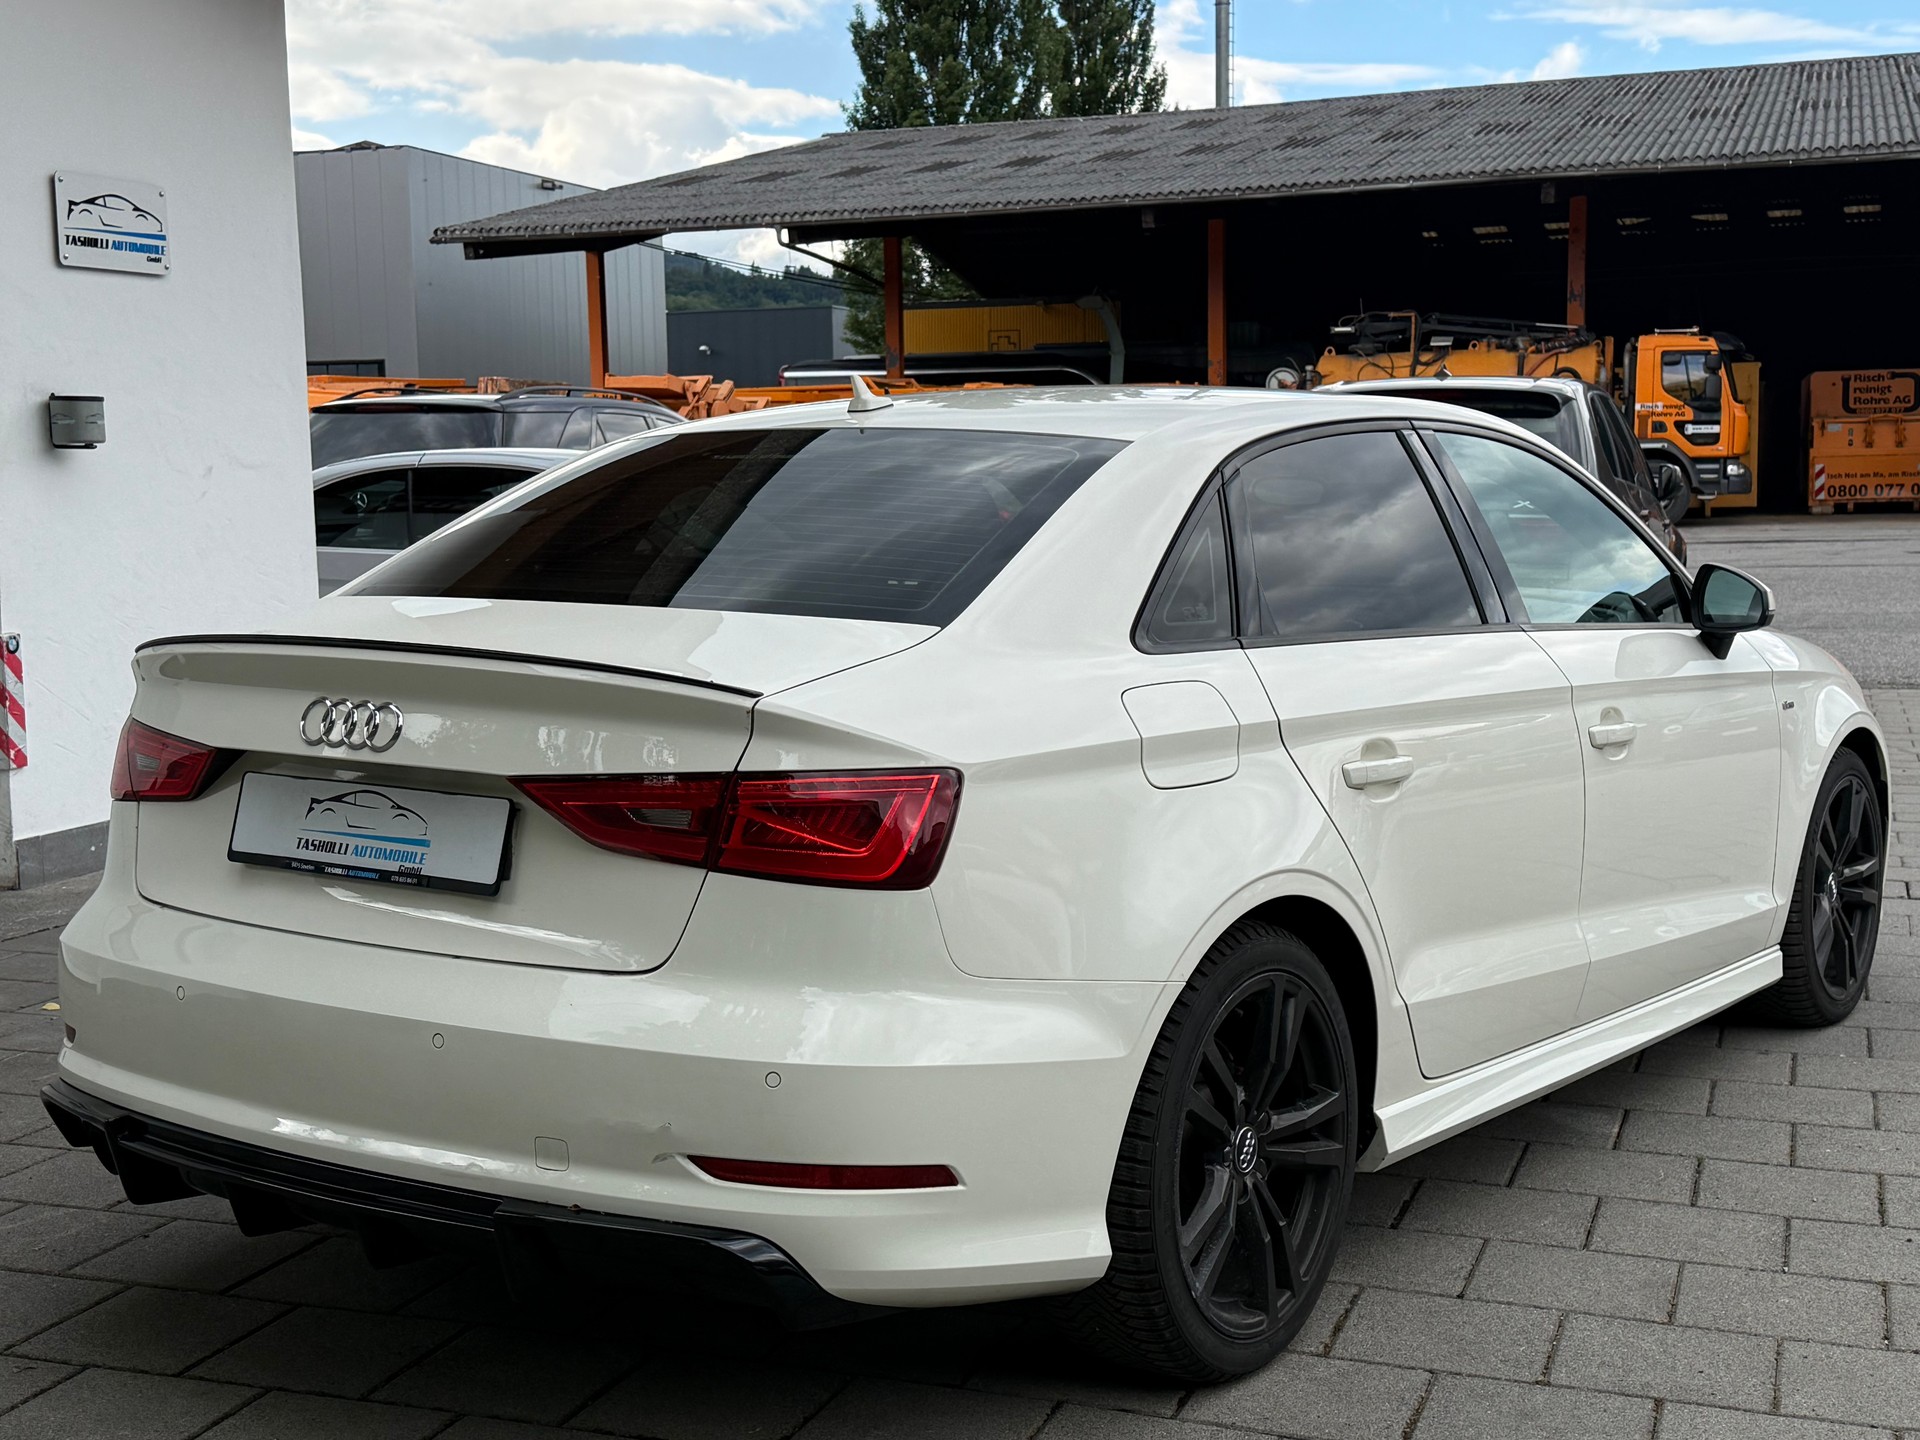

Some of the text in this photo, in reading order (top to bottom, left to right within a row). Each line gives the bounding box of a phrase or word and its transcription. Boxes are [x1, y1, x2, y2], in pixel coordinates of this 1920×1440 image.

[111, 240, 166, 256] AUTOMOBILE
[1854, 374, 1885, 382] Risch
[1854, 384, 1892, 395] reinigt
[1854, 395, 1911, 405] Rohre AG
[1827, 484, 1868, 498] 0800
[1874, 483, 1905, 497] 077
[296, 837, 428, 865] TASHOLLI AUTOMOBILE
[398, 864, 423, 875] GmbH
